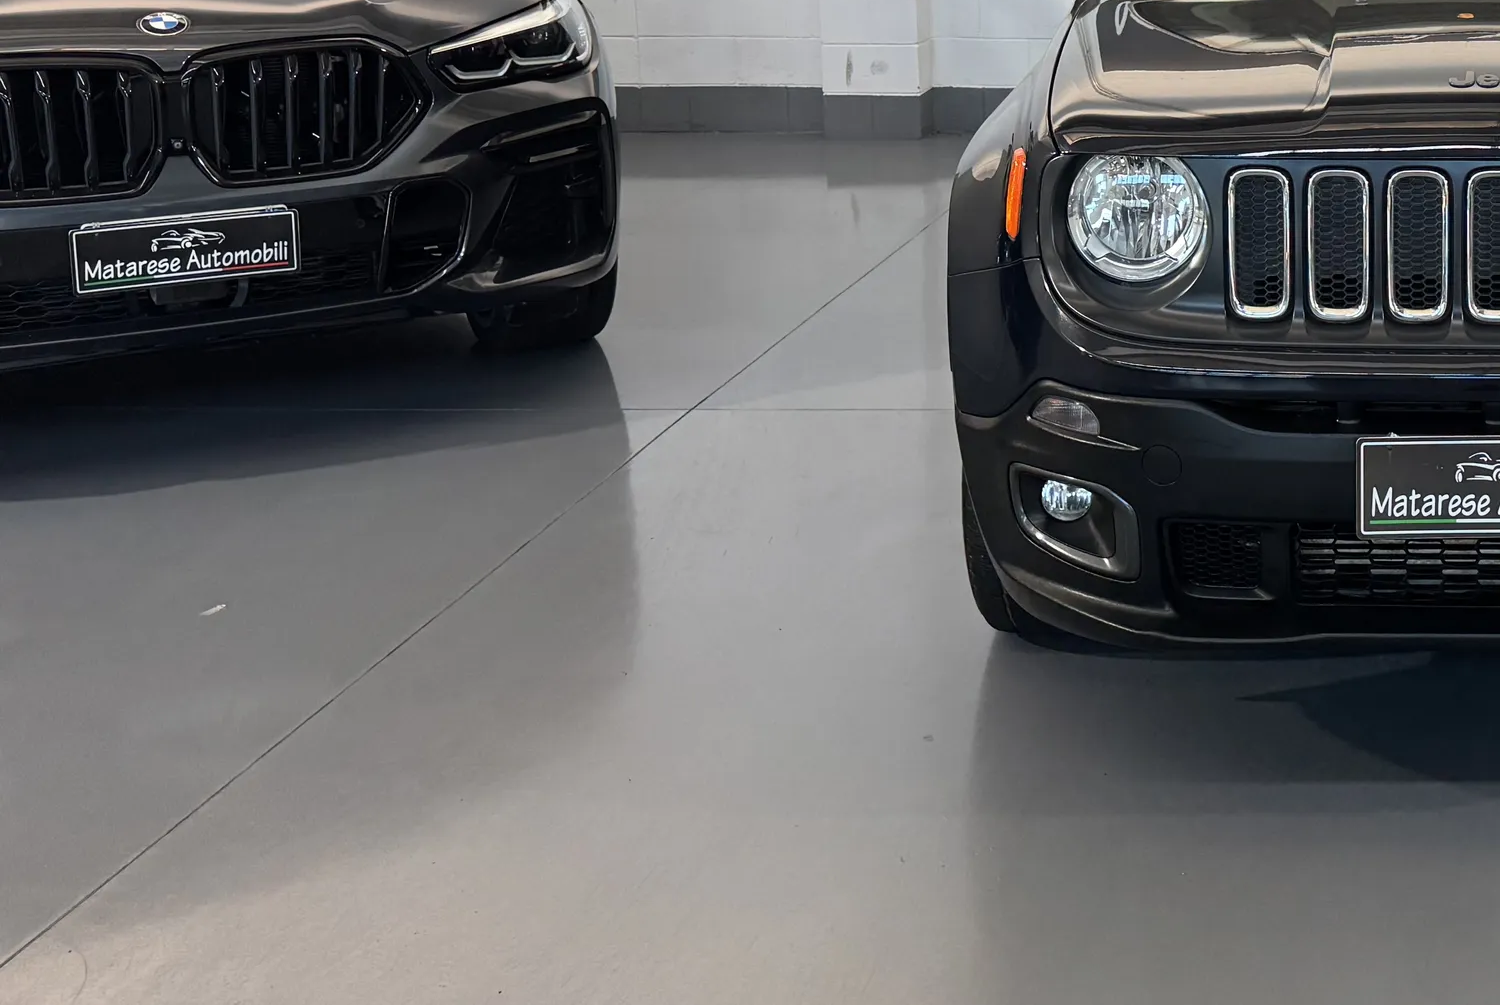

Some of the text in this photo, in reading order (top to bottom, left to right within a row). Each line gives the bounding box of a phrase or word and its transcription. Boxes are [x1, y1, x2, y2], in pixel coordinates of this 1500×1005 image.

[84, 241, 288, 281] Matarese Automobili
[1370, 486, 1491, 517] Matarese
